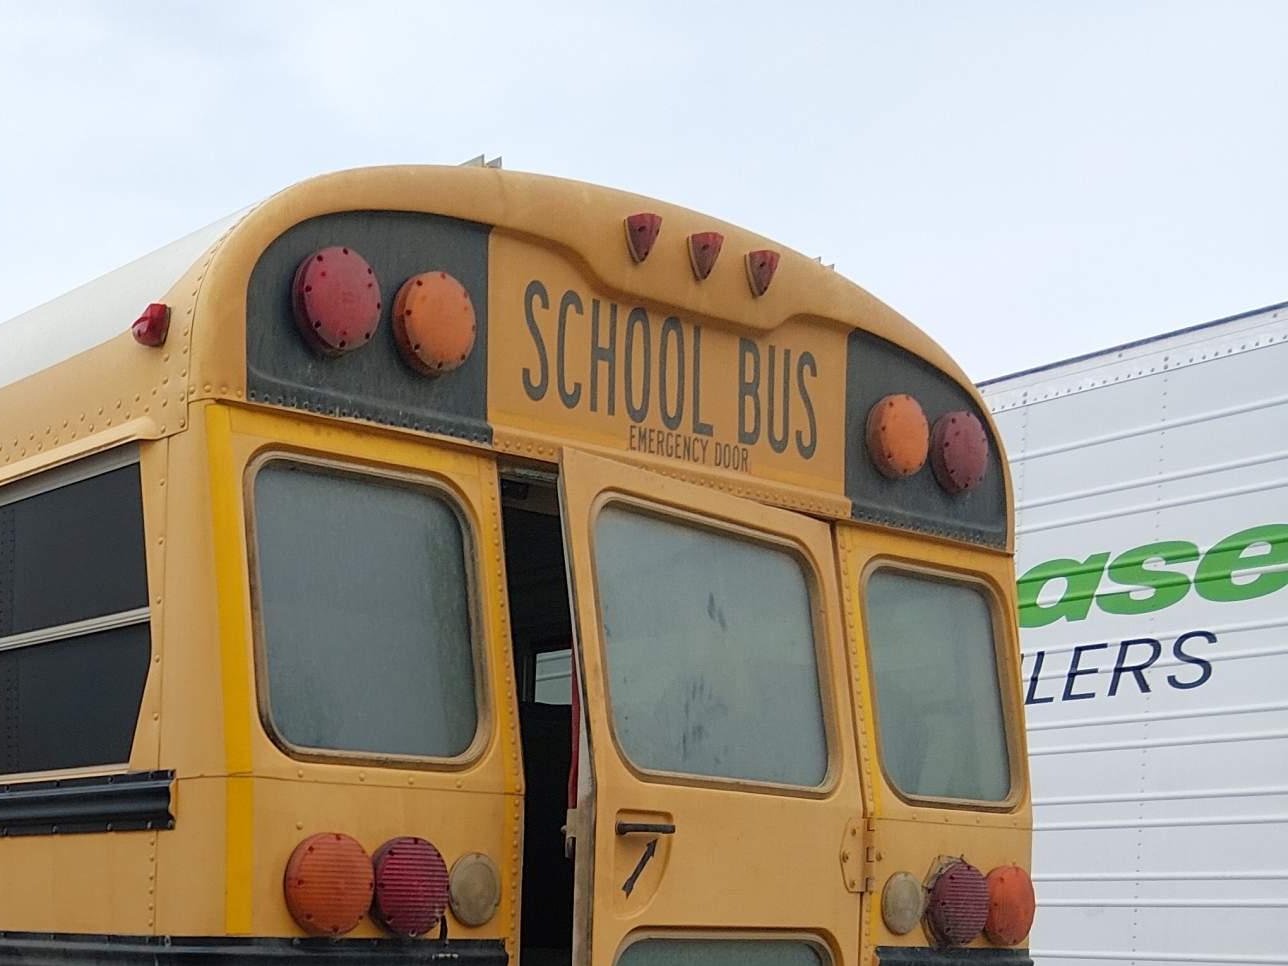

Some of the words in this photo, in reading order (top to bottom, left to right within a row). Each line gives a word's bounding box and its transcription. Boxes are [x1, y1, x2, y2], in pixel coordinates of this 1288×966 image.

[522, 279, 713, 437] SCHOOL
[738, 336, 818, 460] BUS
[629, 425, 709, 464] EMERGENCY
[714, 441, 749, 472] DOOR
